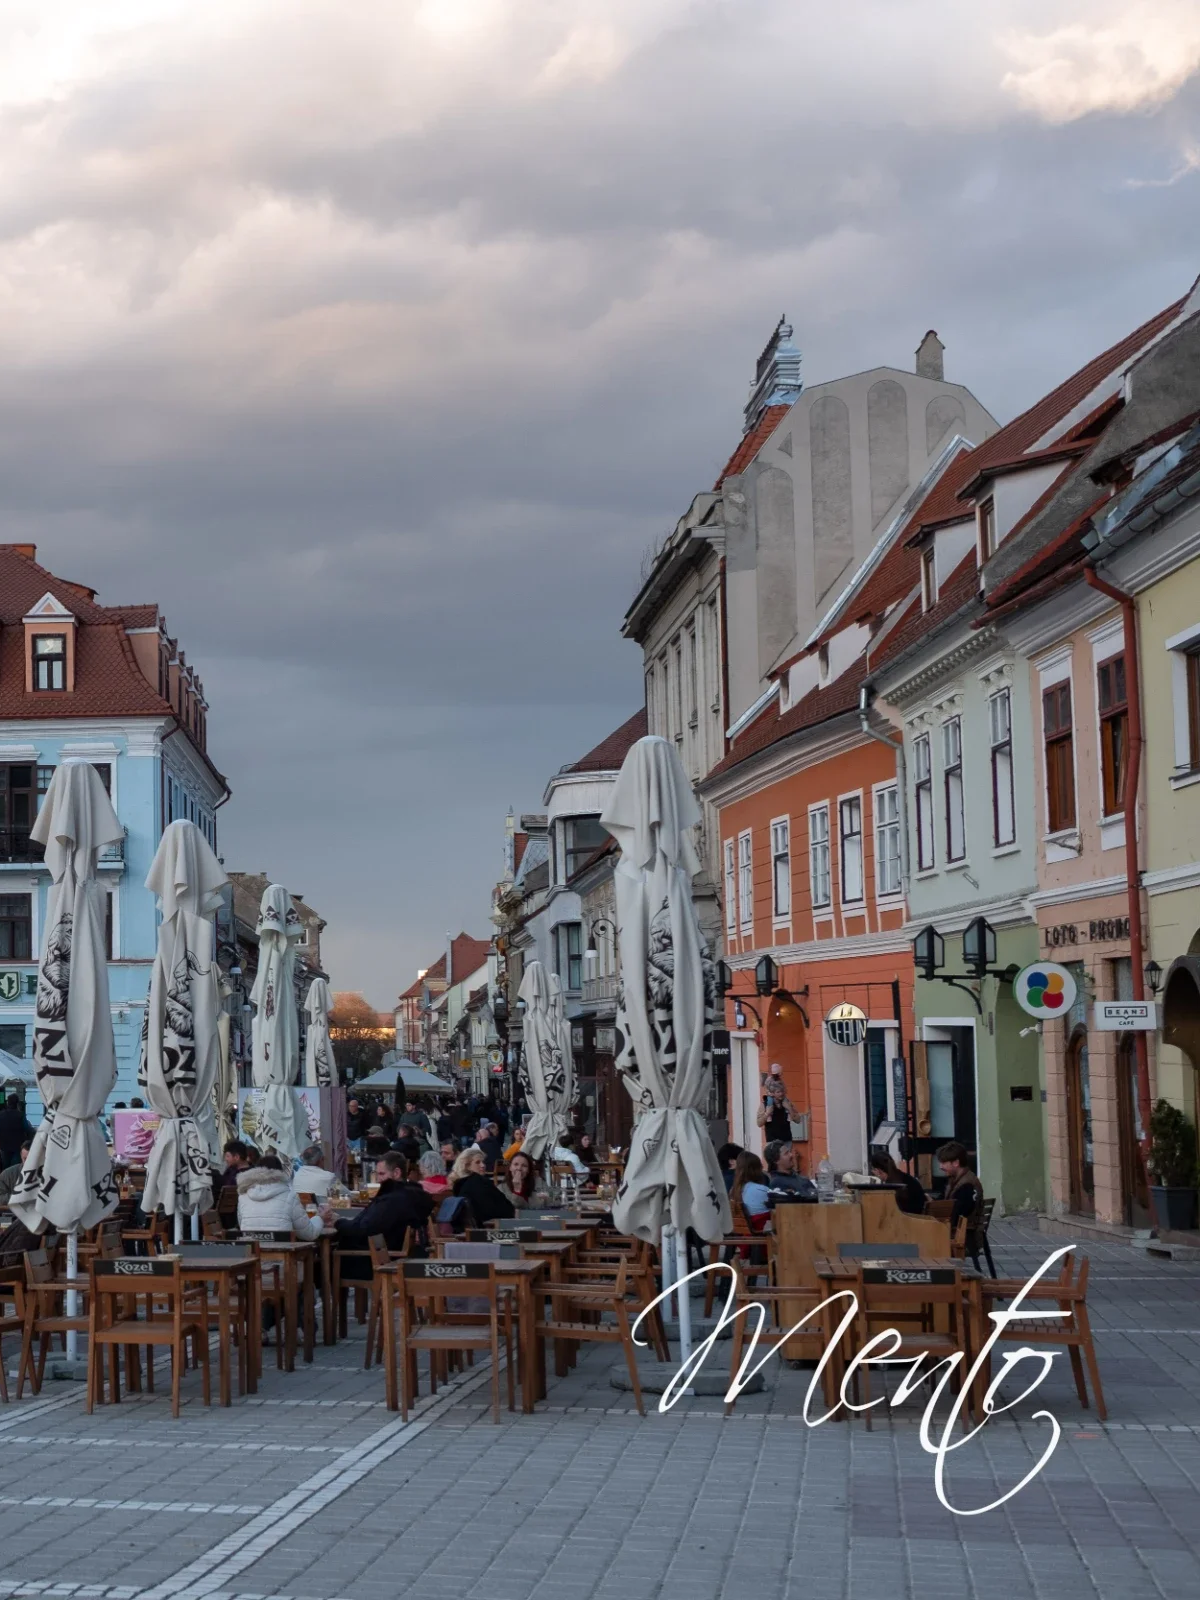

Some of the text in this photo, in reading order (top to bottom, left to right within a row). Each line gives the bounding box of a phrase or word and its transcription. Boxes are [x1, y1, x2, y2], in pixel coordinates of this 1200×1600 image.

[486, 1230, 520, 1241] Kozel
[114, 1261, 154, 1275] Kozel
[424, 1263, 467, 1277] Kozel
[885, 1269, 932, 1283] Kozel
